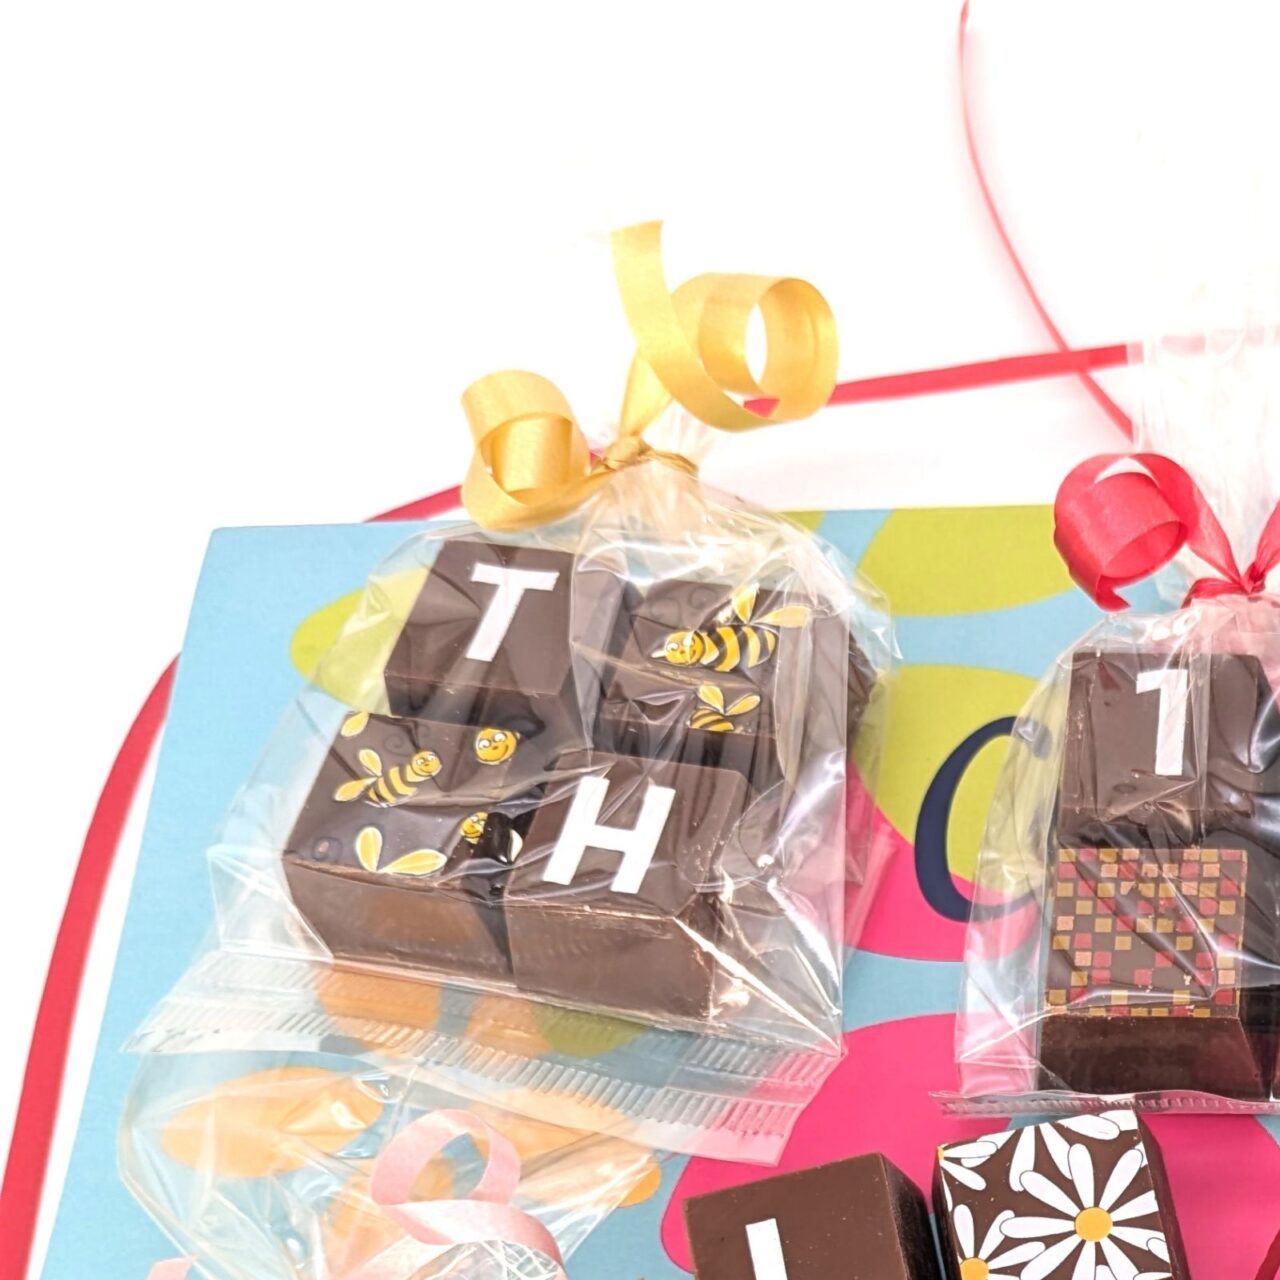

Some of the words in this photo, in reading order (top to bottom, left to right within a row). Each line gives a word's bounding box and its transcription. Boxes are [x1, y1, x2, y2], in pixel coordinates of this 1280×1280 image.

[467, 565, 559, 661] T
[1136, 669, 1192, 775] 1
[541, 777, 676, 893] H
